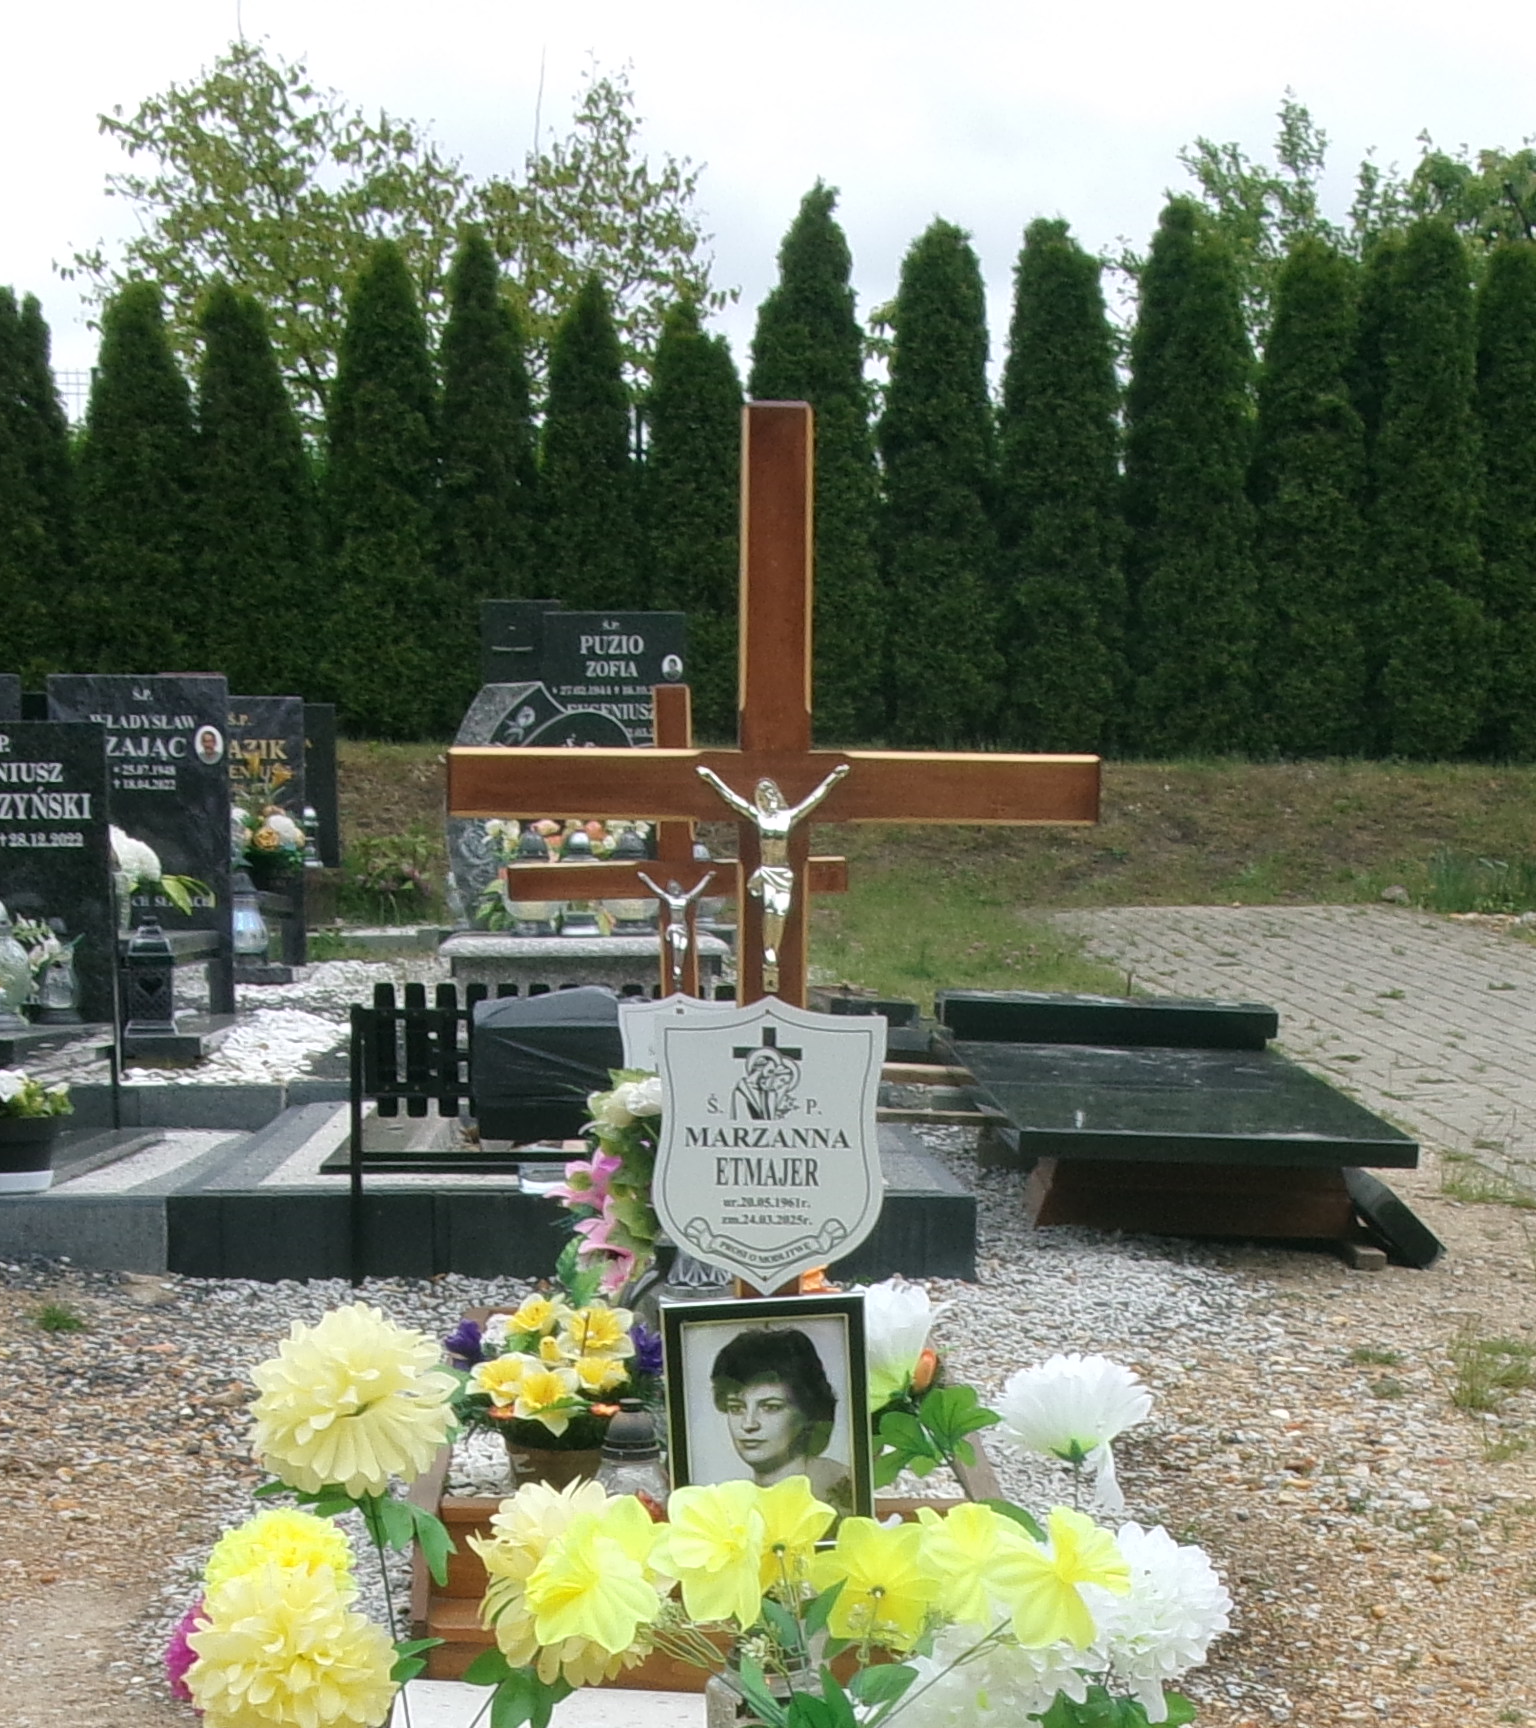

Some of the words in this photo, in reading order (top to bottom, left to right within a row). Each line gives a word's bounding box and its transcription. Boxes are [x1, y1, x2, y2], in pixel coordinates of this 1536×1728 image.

[579, 635, 645, 655] PUZIO
[585, 661, 639, 678] ZOFIA
[105, 736, 188, 761] ZAJĄC
[227, 739, 289, 760] AZIK
[805, 1098, 823, 1116] P.
[684, 1126, 852, 1149] MARZANNA
[714, 1156, 820, 1187] ETMAJER
